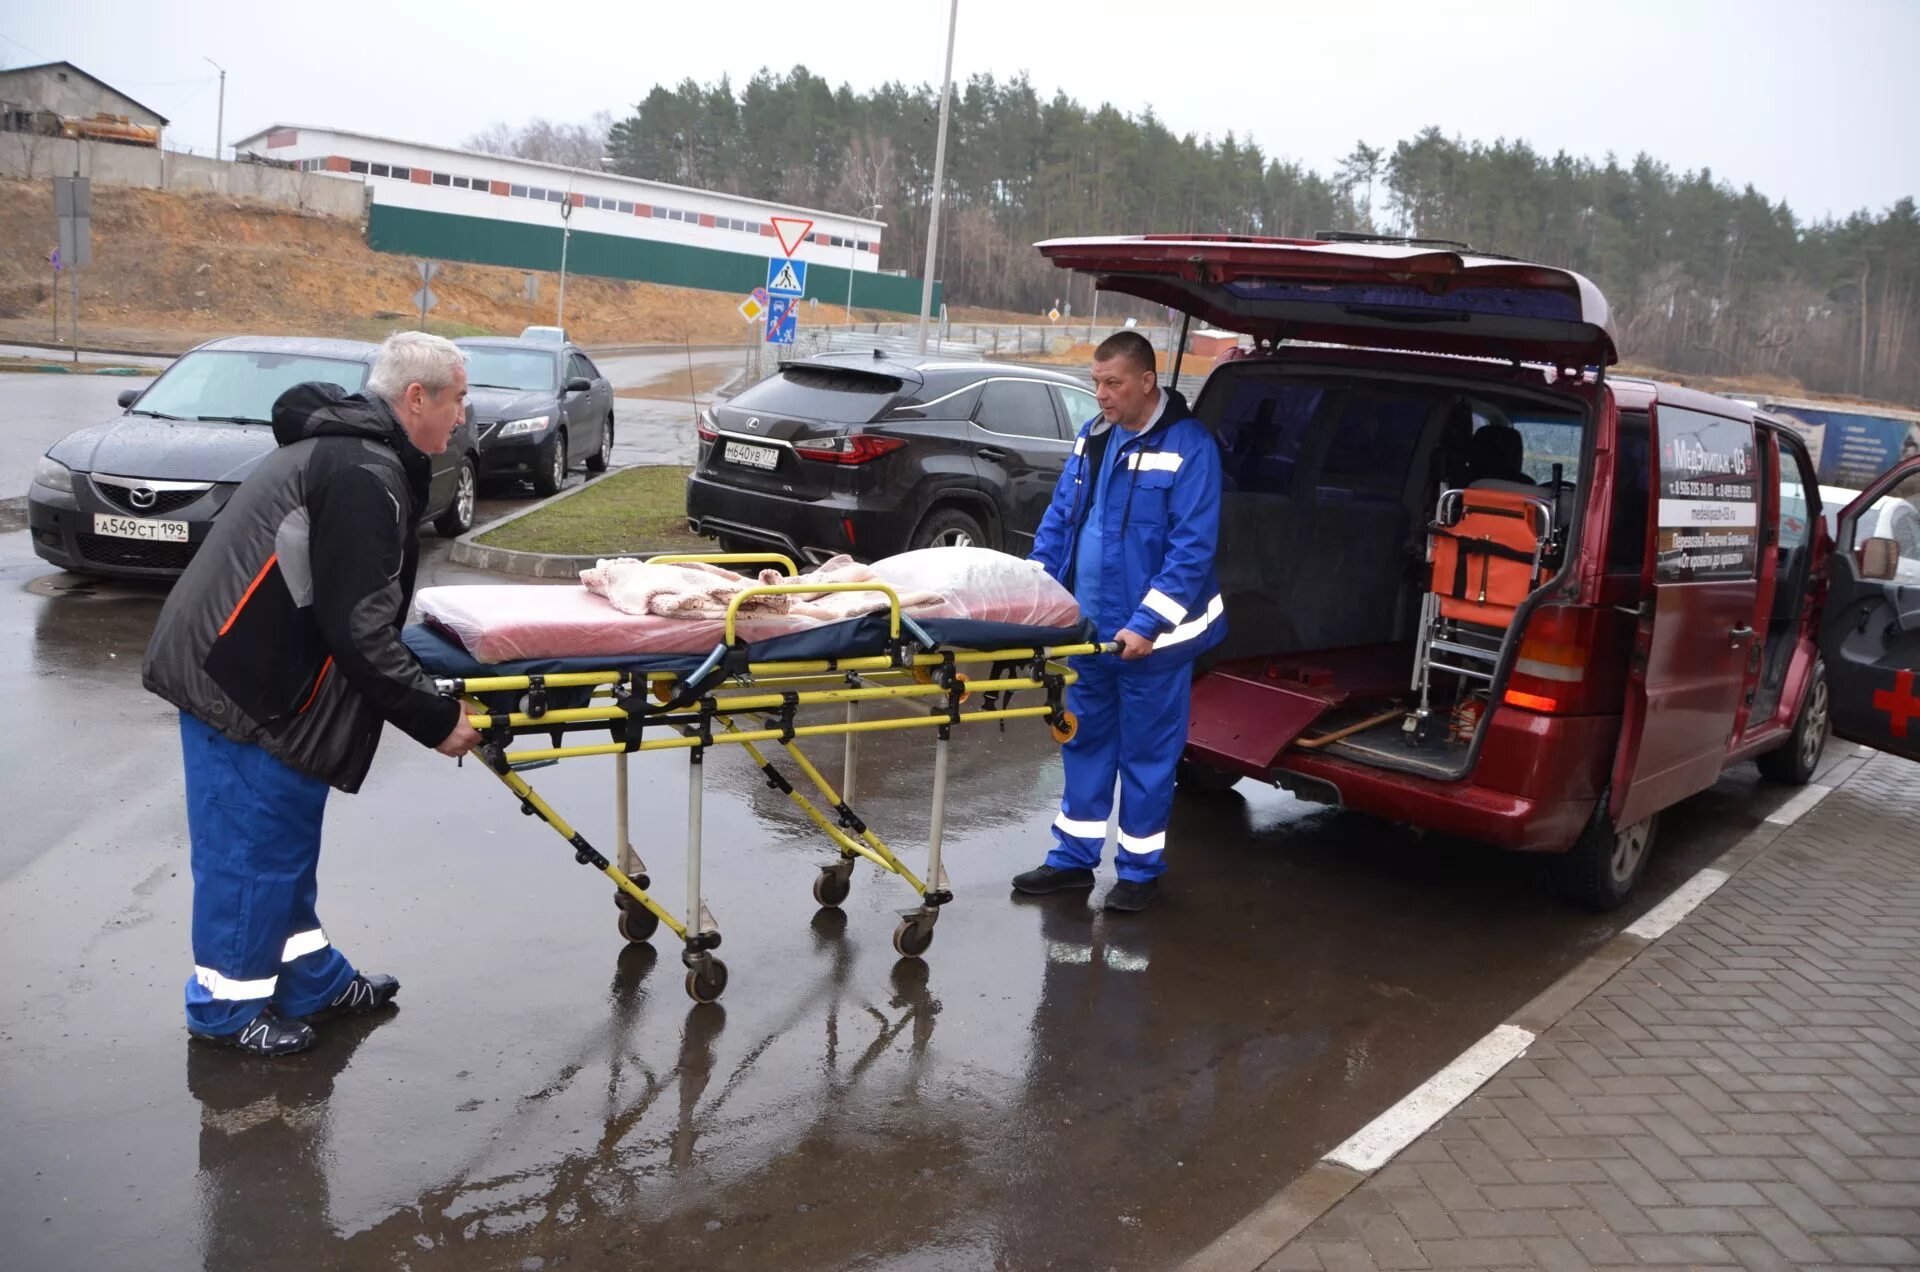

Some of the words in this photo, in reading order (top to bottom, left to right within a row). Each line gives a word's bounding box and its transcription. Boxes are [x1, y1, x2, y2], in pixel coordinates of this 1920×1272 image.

[1734, 447, 1746, 476] 03
[101, 518, 156, 537] А549СТ
[160, 523, 184, 535] 199
[1672, 532, 1704, 552] Перевозка
[1690, 555, 1712, 571] кровати
[1712, 554, 1720, 569] до
